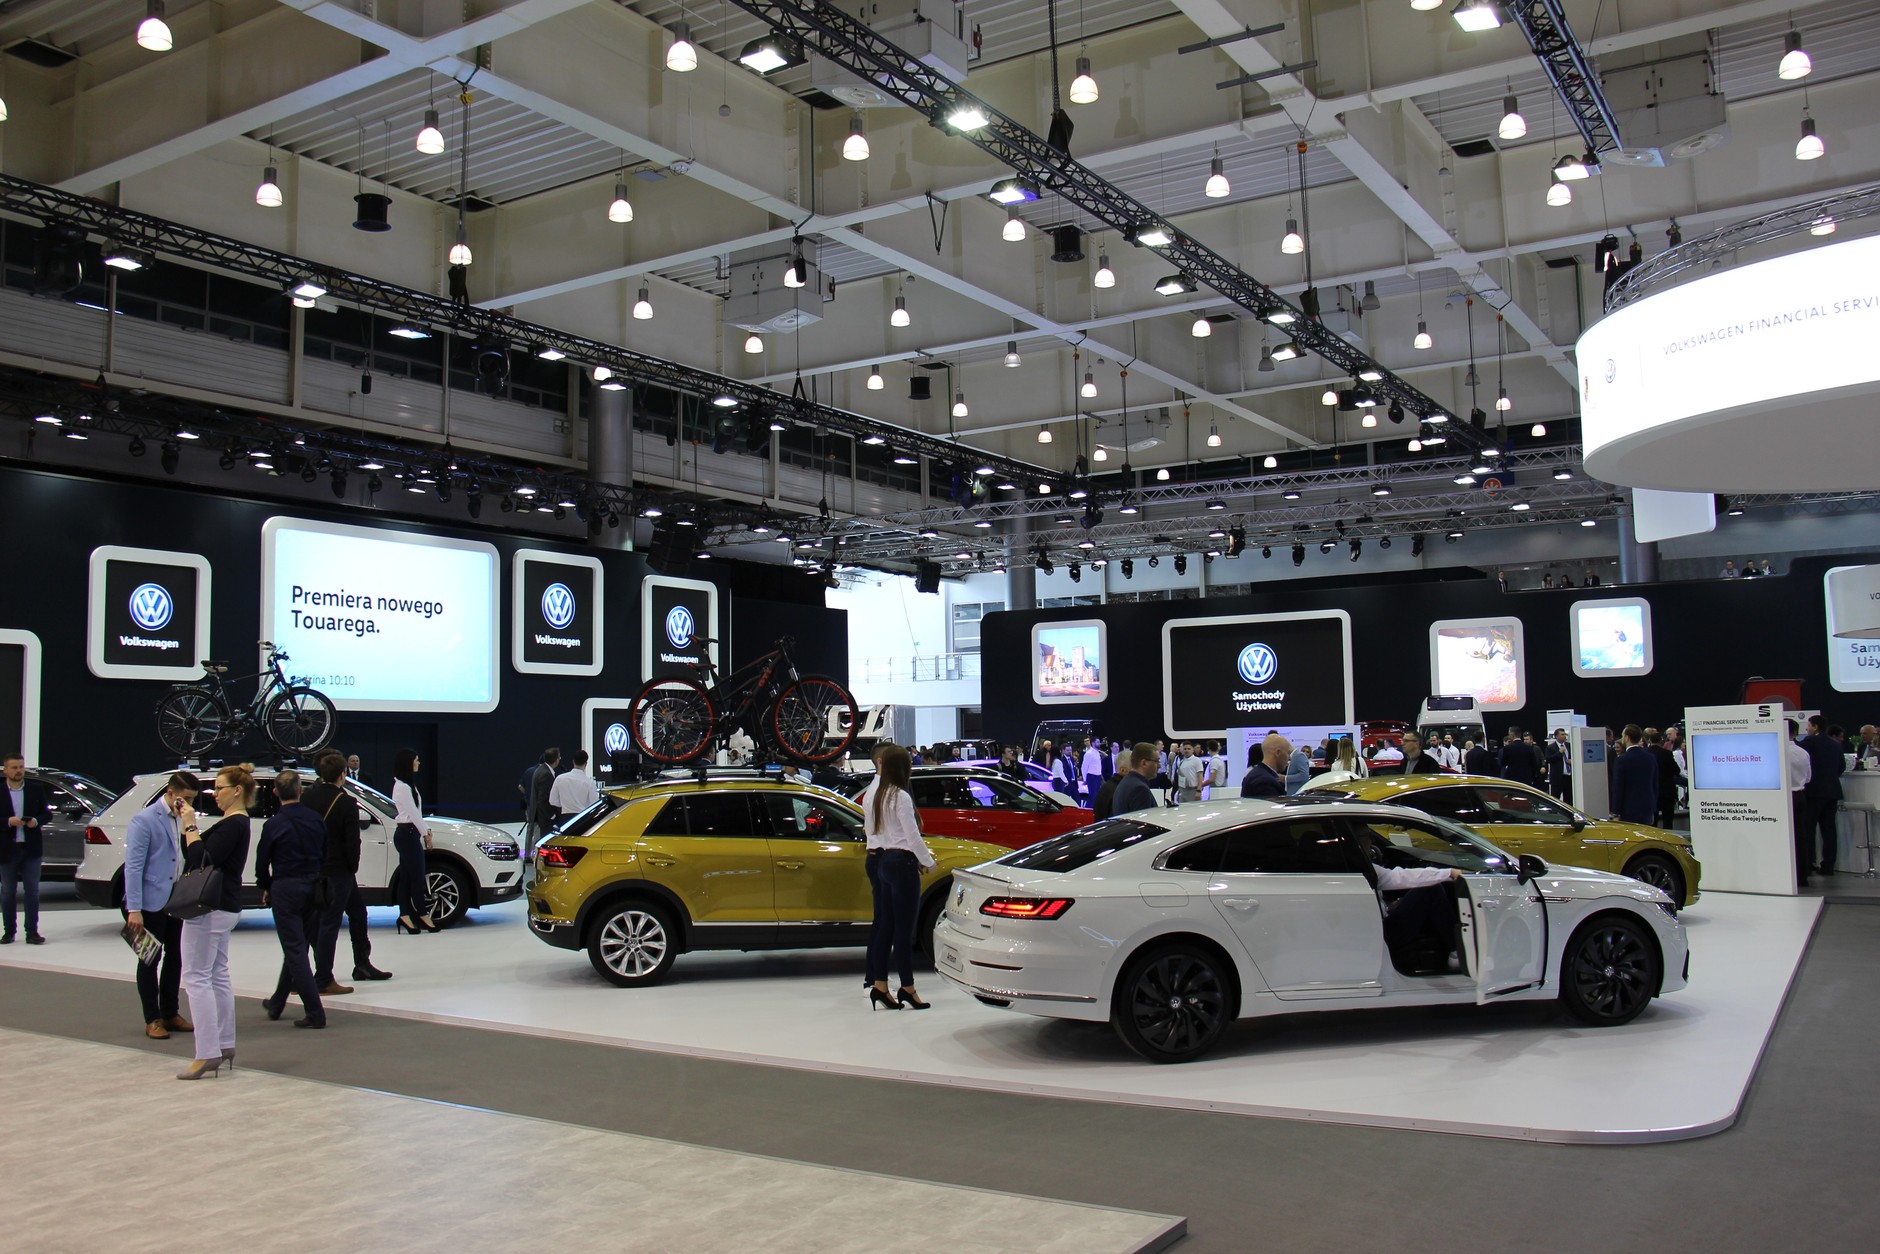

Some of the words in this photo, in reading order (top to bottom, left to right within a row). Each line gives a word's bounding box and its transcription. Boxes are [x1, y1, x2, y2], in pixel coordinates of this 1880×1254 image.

[1663, 324, 1745, 355] VOLKSWAGEN
[1749, 305, 1829, 333] FINANCIAL
[1833, 295, 1879, 314] SERVI
[291, 585, 372, 610] Premiera
[377, 597, 443, 619] nowego
[291, 609, 380, 637] Touarega.
[119, 635, 179, 650] Volkswagen
[535, 633, 581, 648] Volkswagen
[329, 674, 356, 686] 10:10
[1232, 689, 1285, 701] Samochody
[1235, 701, 1282, 713] Użytkowe
[1703, 719, 1726, 727] FINANCIAL
[1726, 718, 1749, 726] SERVICES
[1711, 755, 1725, 763] Moc
[1726, 754, 1750, 763] Niskich
[1742, 815, 1761, 823] Twojej
[1761, 815, 1778, 823] firmy.
